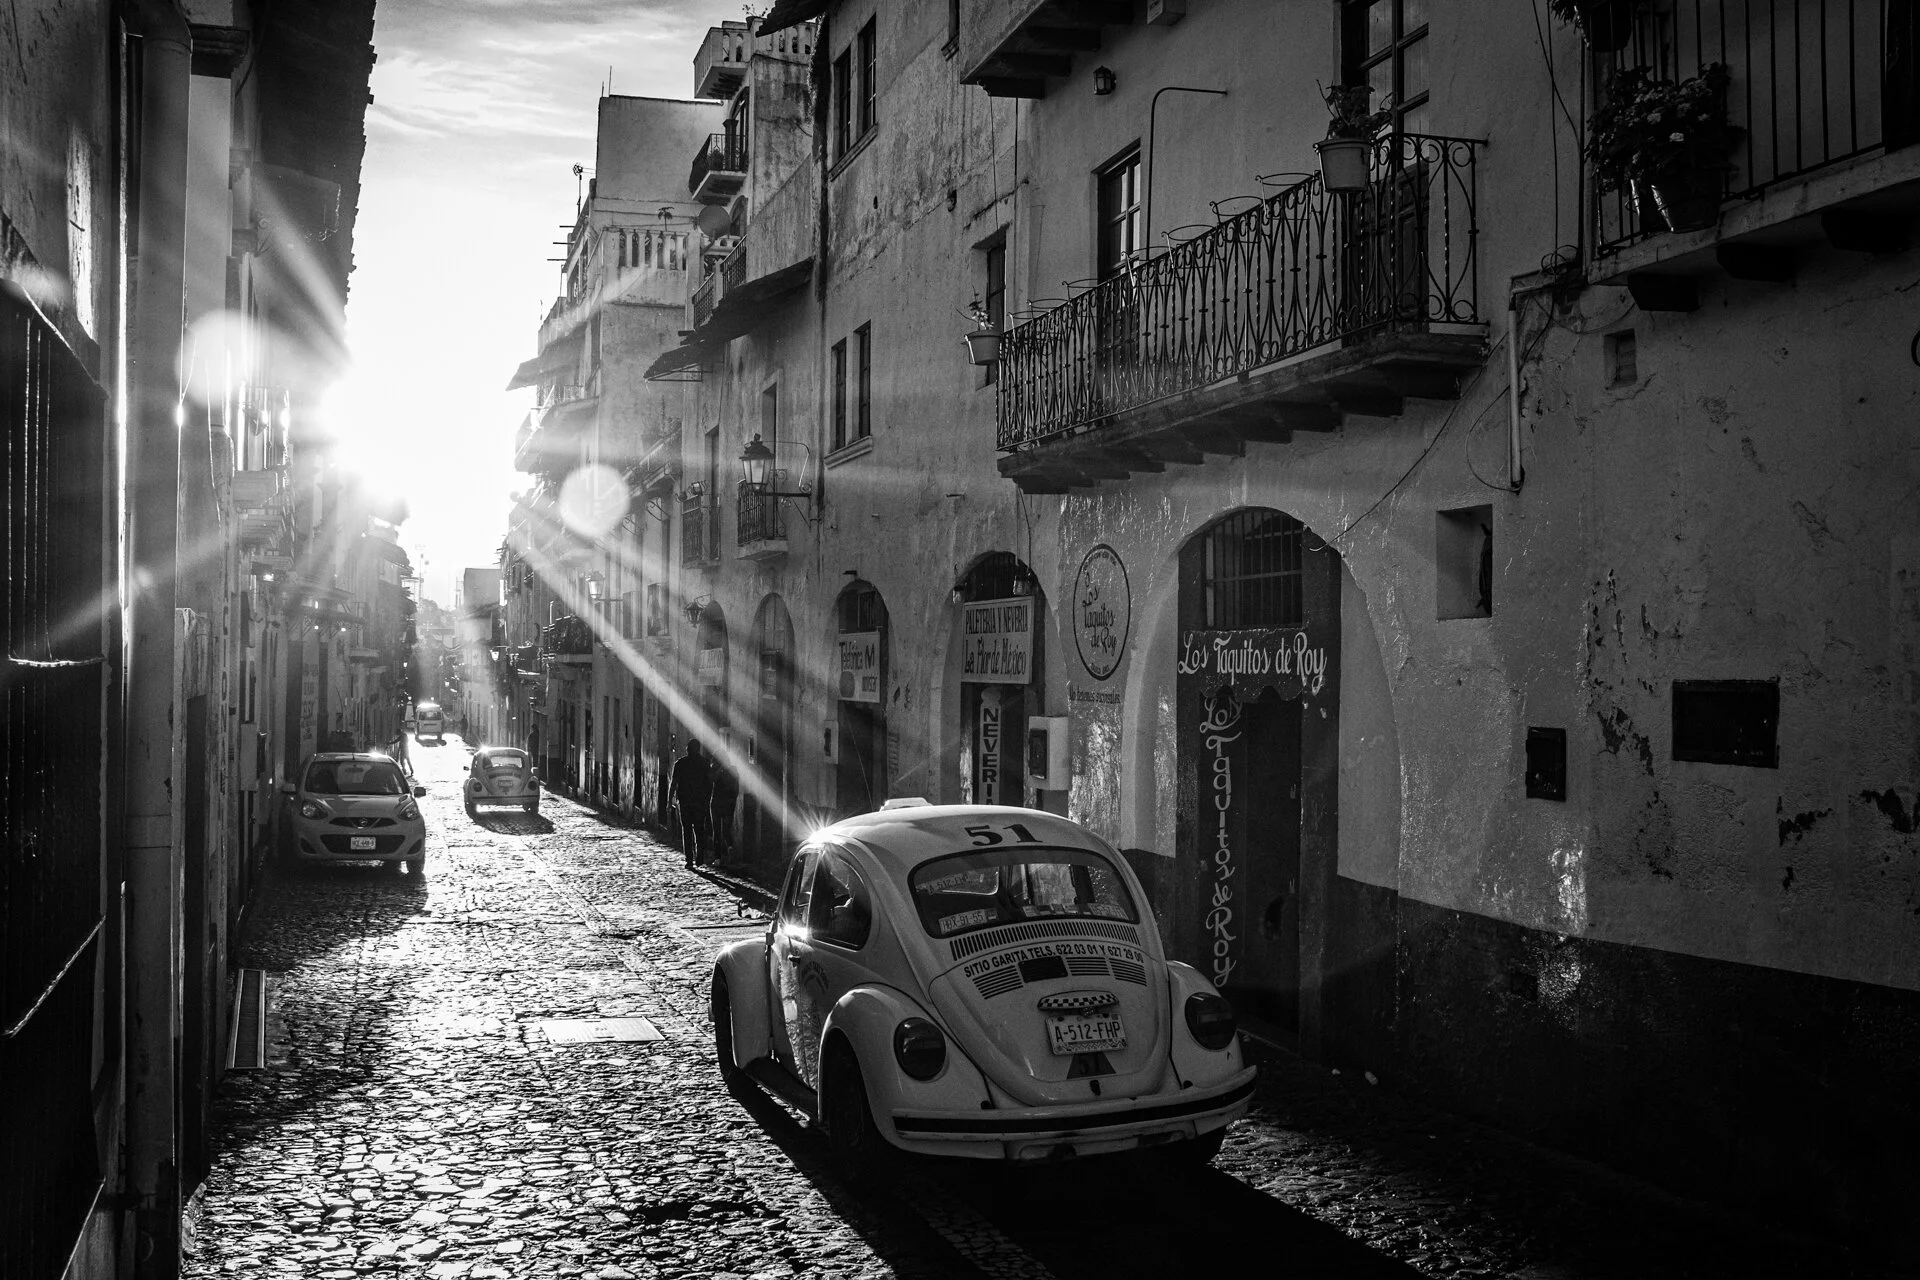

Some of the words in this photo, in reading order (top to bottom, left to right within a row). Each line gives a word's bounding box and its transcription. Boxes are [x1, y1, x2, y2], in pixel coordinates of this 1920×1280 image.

[1082, 572, 1100, 608] Los
[965, 608, 996, 634] PALETERIA
[997, 607, 1002, 633] Y
[1003, 604, 1028, 632] NEVERIA
[1084, 602, 1115, 632] Taquitos
[965, 639, 974, 674] La
[976, 636, 991, 674] Flor
[991, 639, 1000, 674] de
[1091, 630, 1100, 648] de
[1100, 626, 1117, 657] Roy
[1178, 630, 1209, 675] Los
[1213, 635, 1271, 685] Taquitos
[1275, 637, 1292, 676] de
[1293, 631, 1328, 696] Roy
[1199, 696, 1243, 734] Los
[1205, 731, 1242, 882] Taquitos
[964, 823, 1043, 847] 51
[1211, 882, 1233, 908] de
[964, 959, 990, 978] SITIO
[992, 950, 1028, 969] GARITA
[1028, 945, 1055, 959] TELS.
[1056, 944, 1073, 955] 622
[1074, 944, 1086, 955] 03
[1087, 945, 1098, 955] 01
[1099, 945, 1106, 955] Y
[1108, 946, 1122, 957] 627
[1123, 949, 1134, 960] 29
[1205, 906, 1237, 988] Roy
[1055, 1021, 1121, 1043] A-512-FHP
